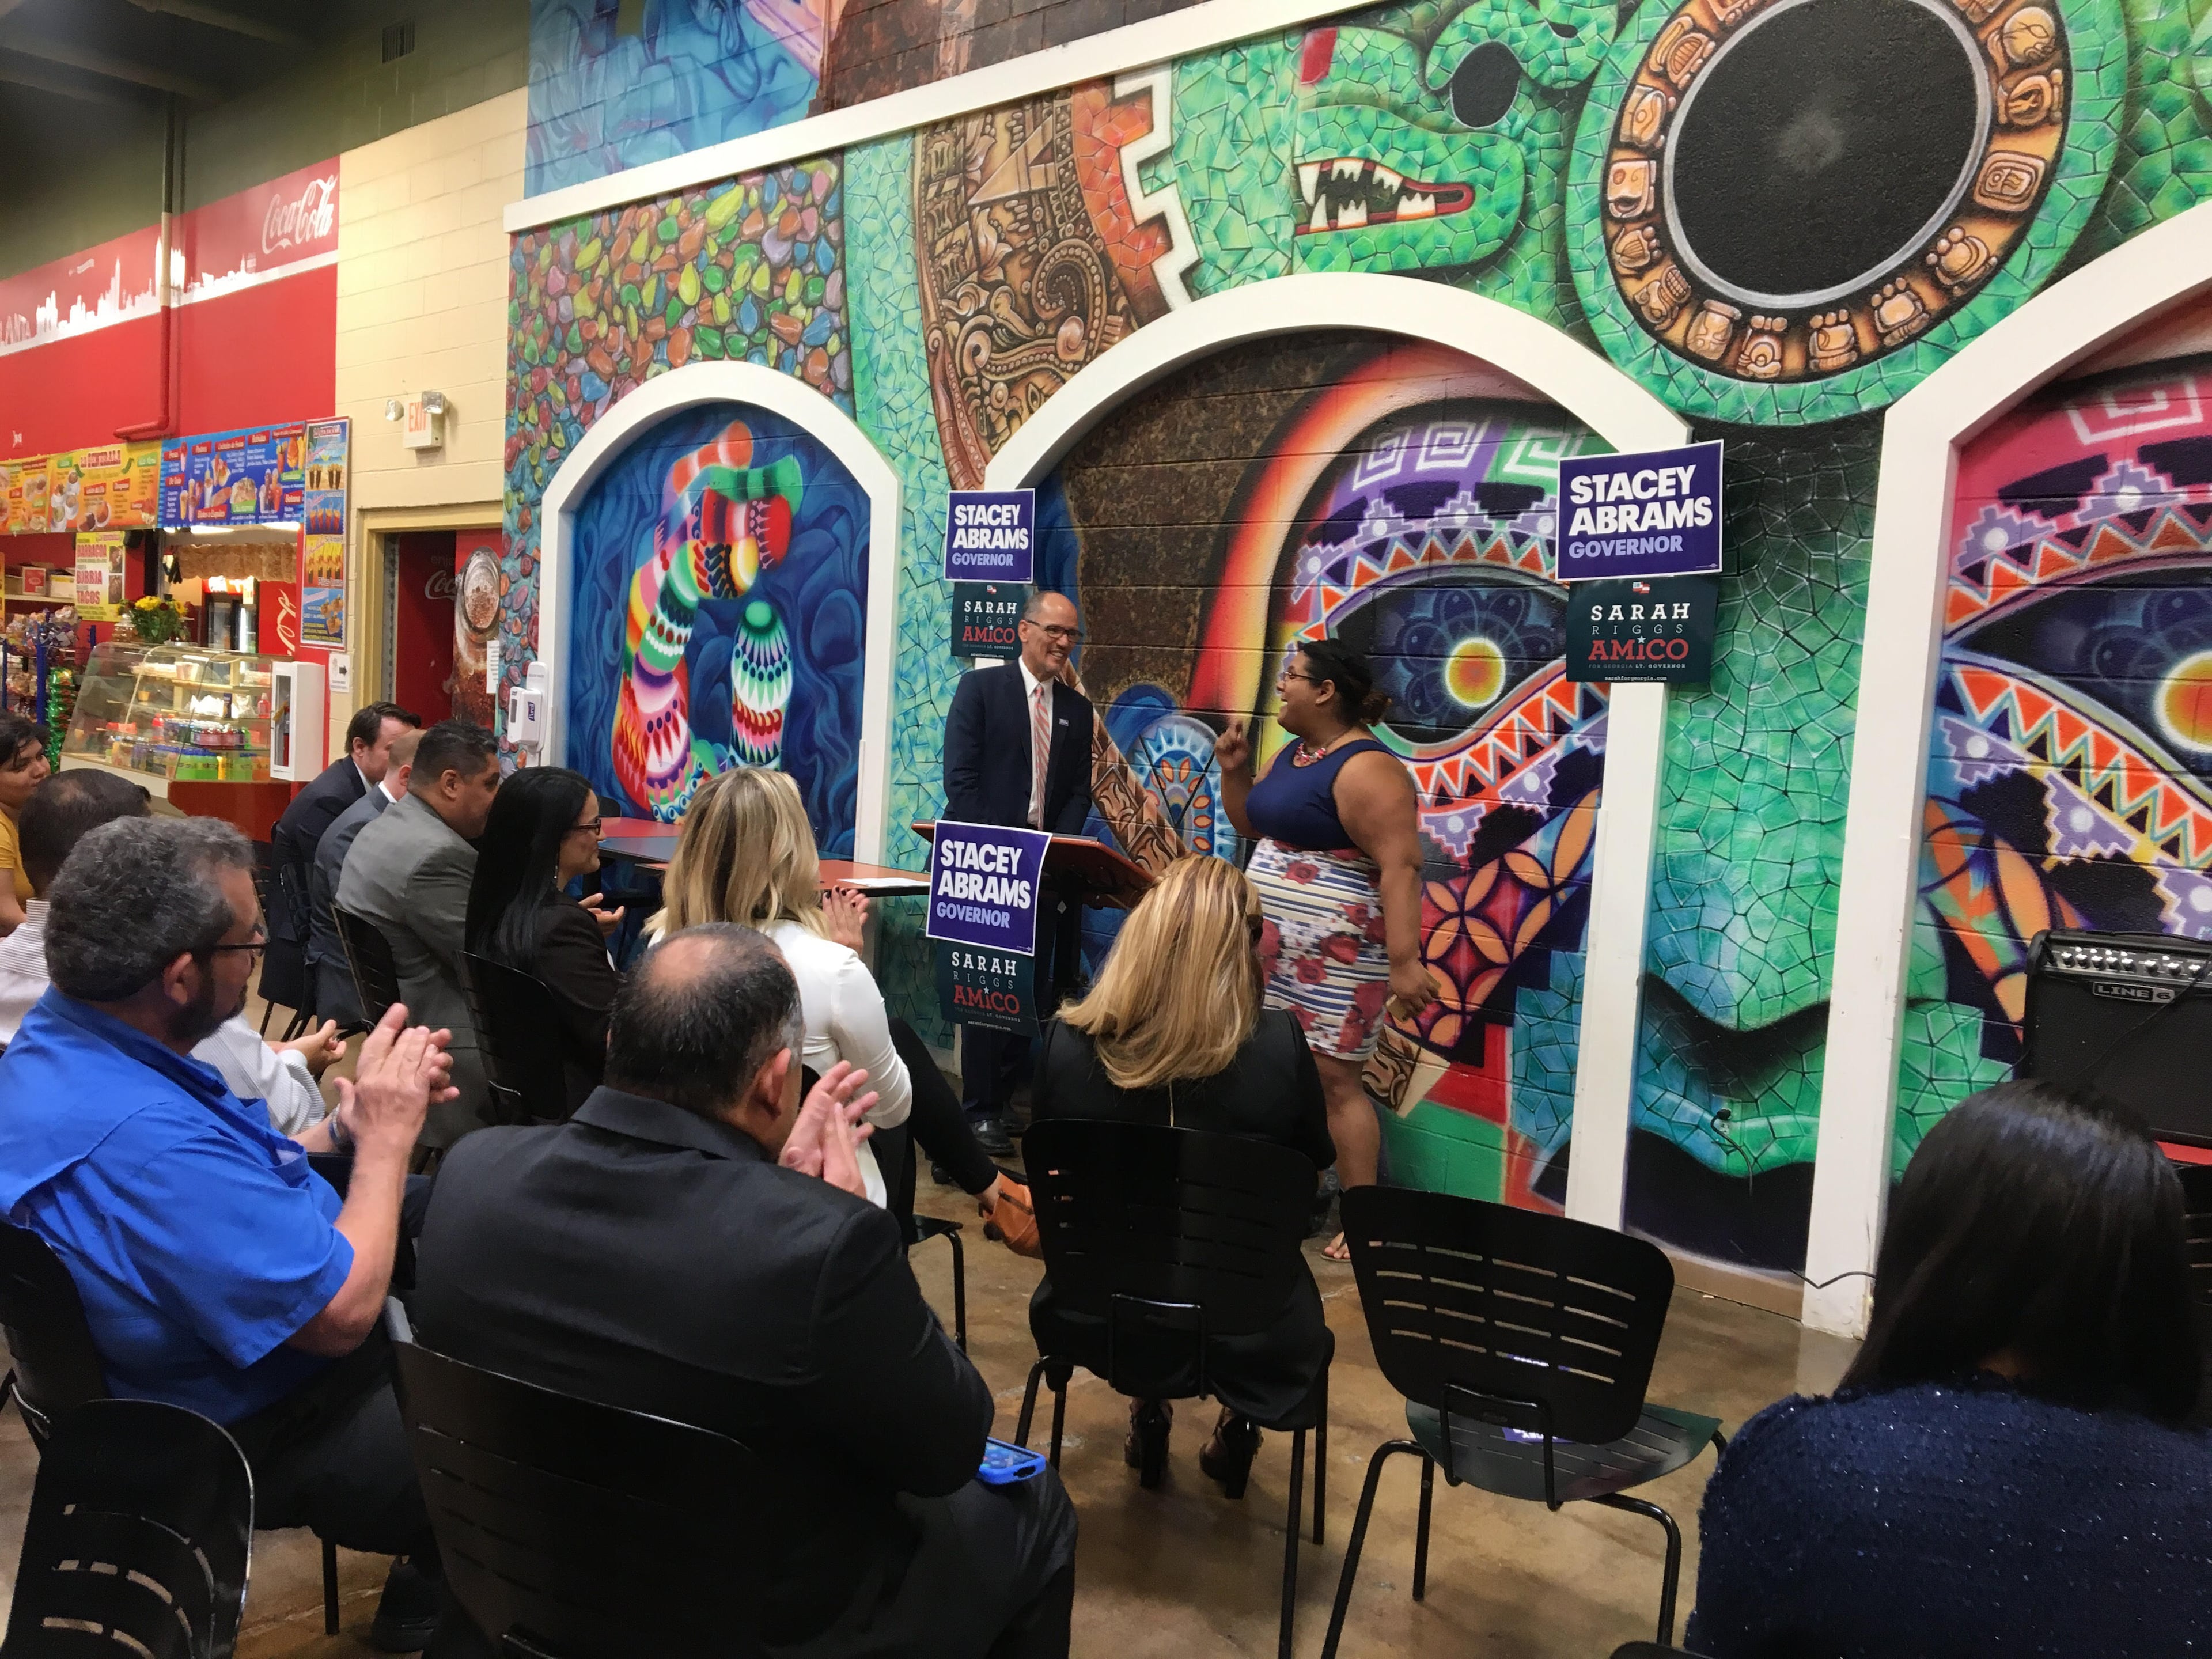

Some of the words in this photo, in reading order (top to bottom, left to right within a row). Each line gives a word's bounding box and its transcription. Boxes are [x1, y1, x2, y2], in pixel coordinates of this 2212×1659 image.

[1570, 464, 1696, 504] STACEY
[954, 504, 1021, 526] STACEY
[1568, 496, 1713, 536] ABRAMS
[952, 528, 1029, 550] ABRAMS
[1569, 535, 1684, 559] GOVERNOR
[952, 552, 1014, 566] GOVERNOR
[76, 570, 103, 584] BIRRIA
[77, 590, 100, 604] TACOS
[964, 600, 1017, 615] SARAH
[1590, 603, 1690, 621] SARAH
[964, 615, 1013, 625] RIGGS
[1592, 624, 1683, 635] RIGGS
[940, 839, 1024, 875] STACEY
[937, 870, 1031, 909] ABRAMS
[936, 902, 1010, 929] GOVERNOR
[951, 951, 1017, 976] SARAH
[953, 971, 1013, 990] RIGGS
[2097, 985, 2150, 998] LINE
[2156, 992, 2171, 1000] 6
